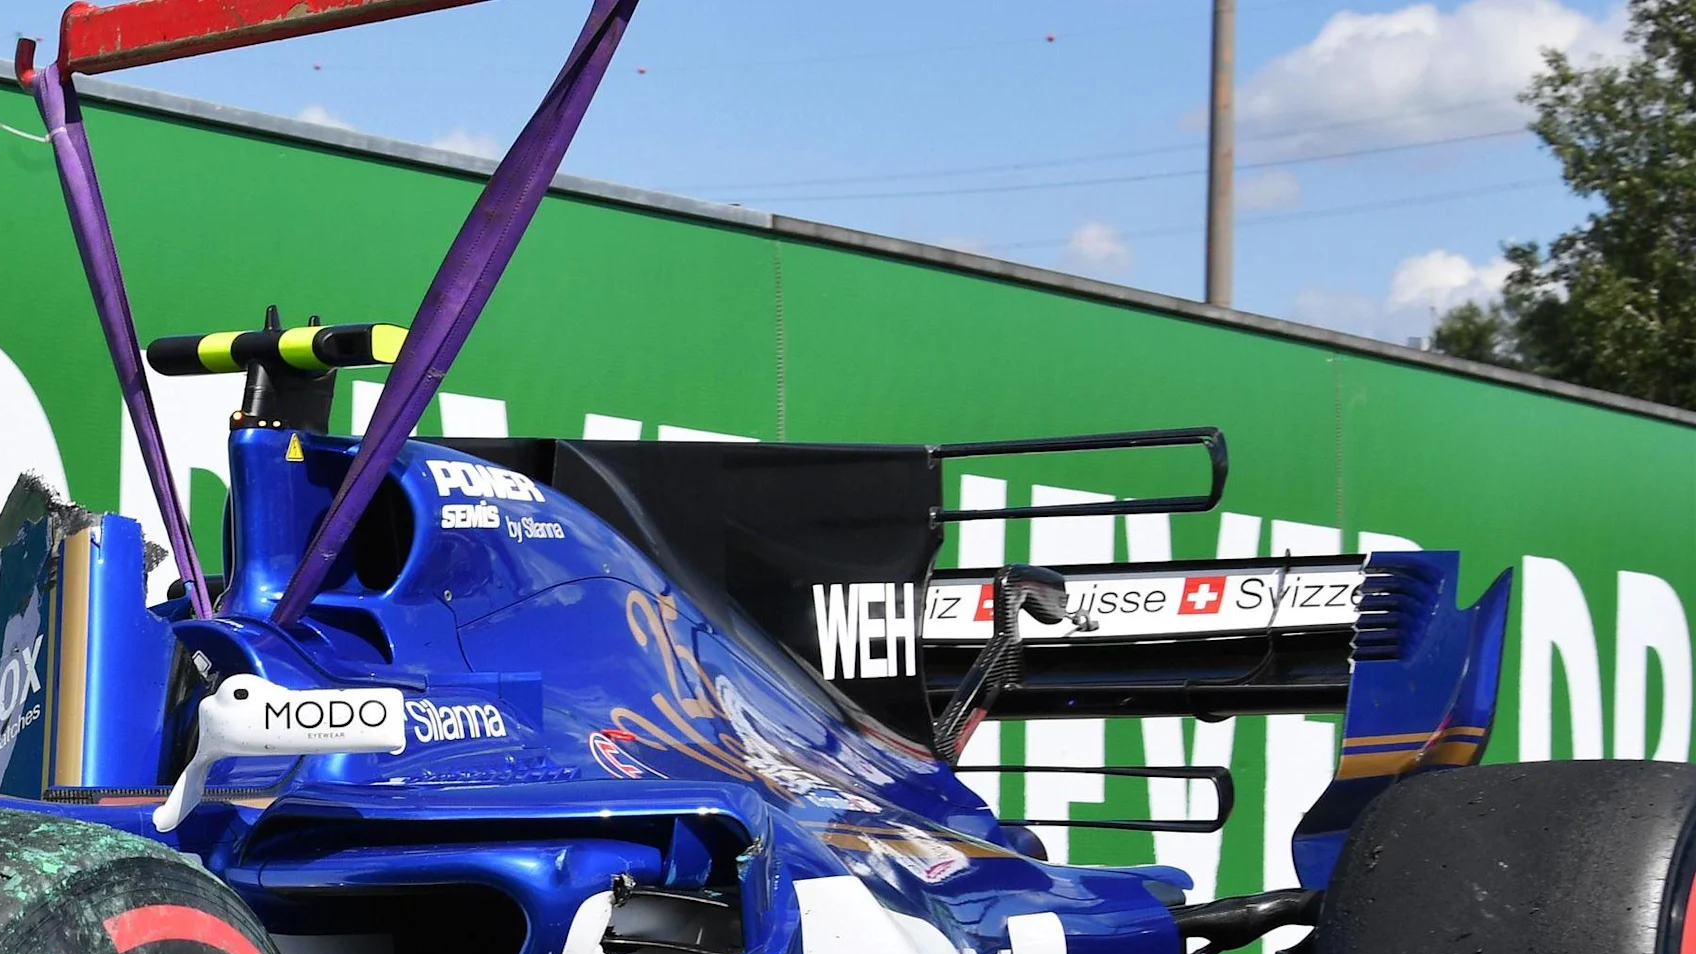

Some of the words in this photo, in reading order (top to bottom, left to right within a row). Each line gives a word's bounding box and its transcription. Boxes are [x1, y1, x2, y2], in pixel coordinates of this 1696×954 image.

[425, 459, 546, 502] POWER
[505, 515, 522, 544] by
[1064, 584, 1166, 614] uisse
[812, 582, 917, 681] WEH
[264, 699, 387, 731] MODO
[405, 698, 507, 744] Silanna
[306, 732, 346, 740] EYEWEAR
